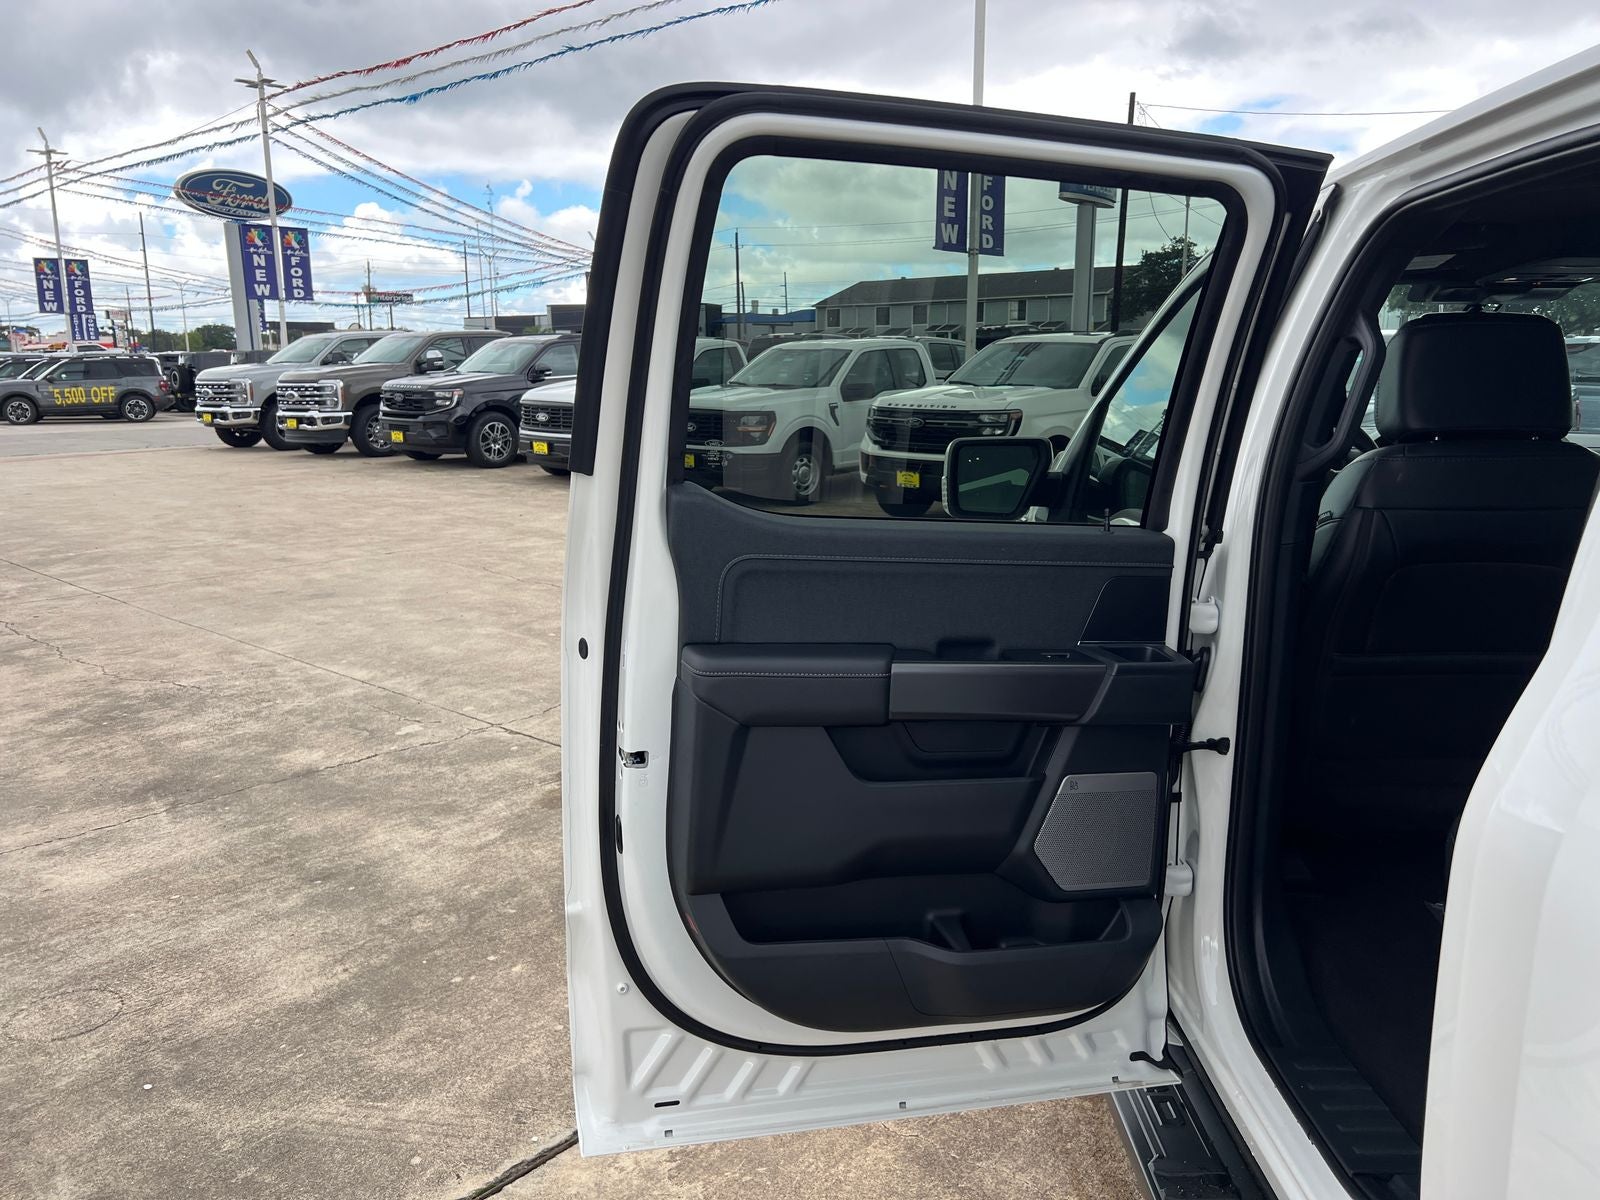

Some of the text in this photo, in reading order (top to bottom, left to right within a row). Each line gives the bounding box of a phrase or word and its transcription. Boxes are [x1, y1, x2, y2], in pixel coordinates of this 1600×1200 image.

[207, 179, 270, 209] Ford
[941, 170, 959, 244] NEW
[981, 175, 994, 249] FORD
[252, 254, 271, 296] NEW
[290, 256, 305, 298] FORD
[42, 279, 58, 311] NEW
[74, 280, 86, 313] FORD
[91, 386, 116, 404] OFF
